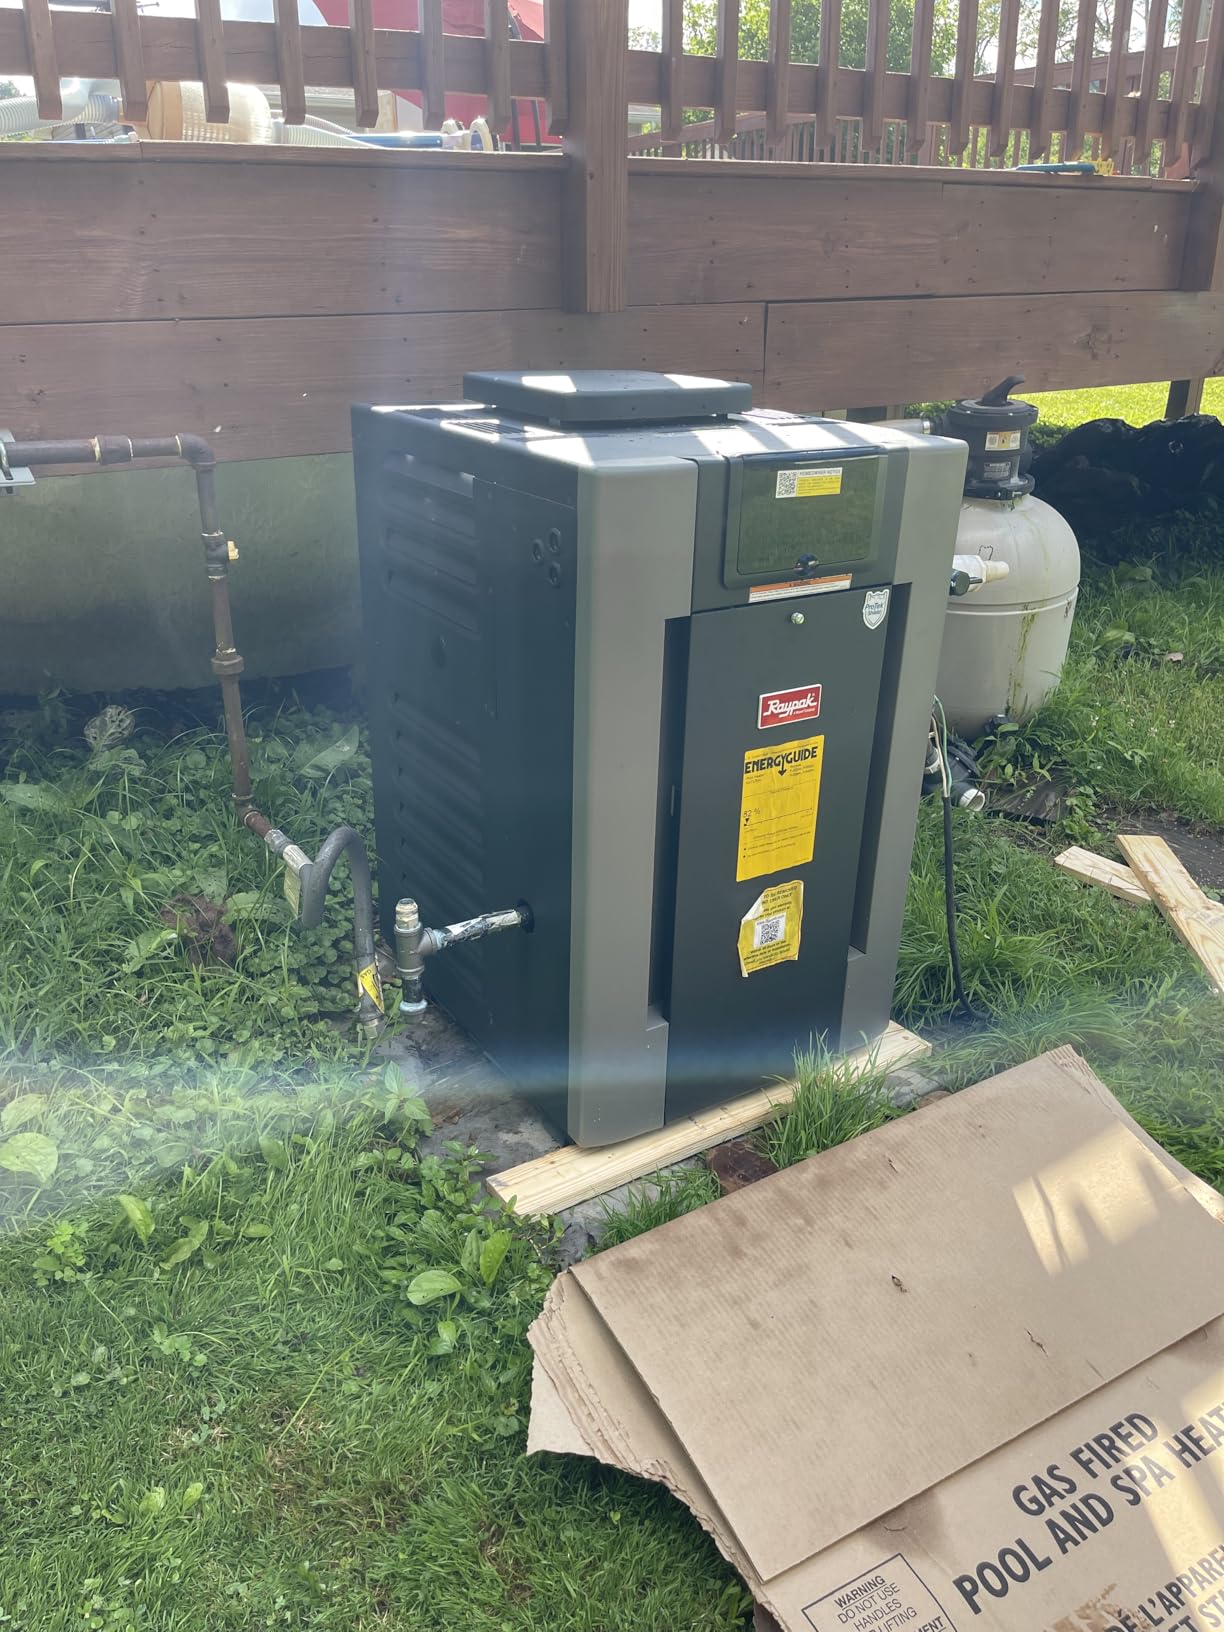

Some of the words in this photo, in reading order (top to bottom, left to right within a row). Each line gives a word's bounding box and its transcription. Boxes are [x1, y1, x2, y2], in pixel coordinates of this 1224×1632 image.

[763, 693, 818, 718] Raypak
[744, 746, 818, 775] ENERGYGUIDE
[1012, 1464, 1077, 1516] GAS
[1069, 1413, 1158, 1479] FIRED
[952, 1538, 1054, 1615] POOL
[1045, 1493, 1114, 1555] AND
[1110, 1455, 1176, 1506] SPA
[834, 1575, 886, 1608] WARNING
[838, 1610, 856, 1624] DO
[855, 1594, 877, 1614] NOT
[876, 1582, 900, 1601] USE
[1138, 1544, 1224, 1627] L'APPARE
[853, 1598, 902, 1632] HANDLES
